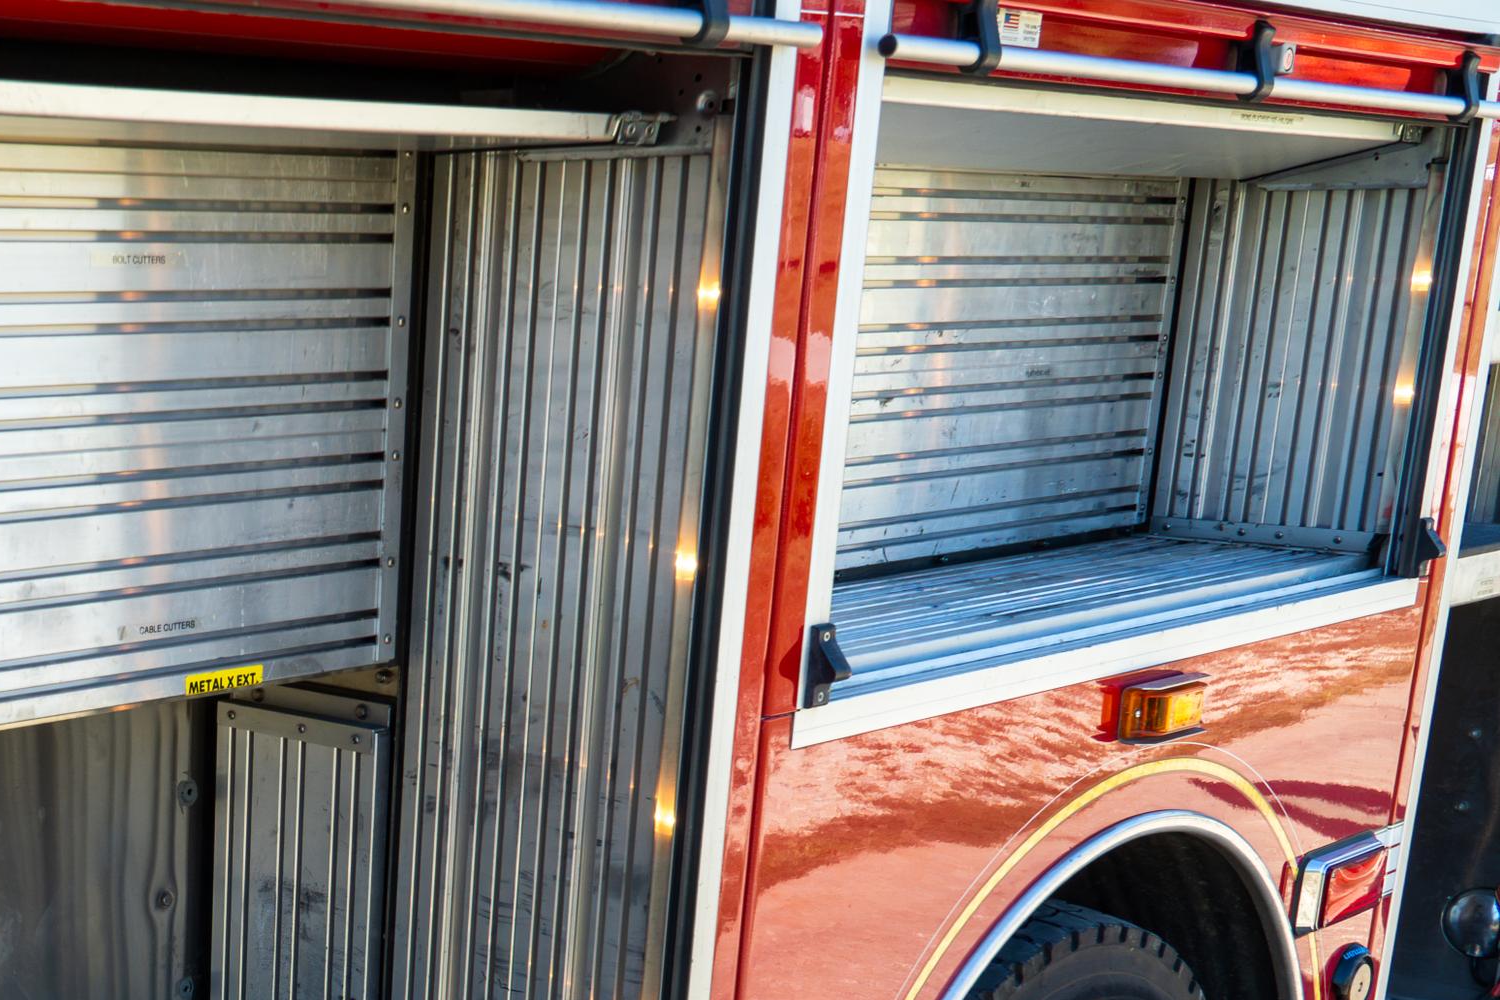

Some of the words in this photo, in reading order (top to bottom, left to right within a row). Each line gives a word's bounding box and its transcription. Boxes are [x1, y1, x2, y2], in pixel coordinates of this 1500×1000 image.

[112, 255, 131, 264] BOLT
[132, 255, 166, 265] CUTTERS
[139, 624, 162, 635] CABLE
[163, 619, 196, 632] CUTTERS
[188, 678, 224, 694] METAL
[227, 676, 235, 688] X
[236, 672, 260, 687] EXT.
